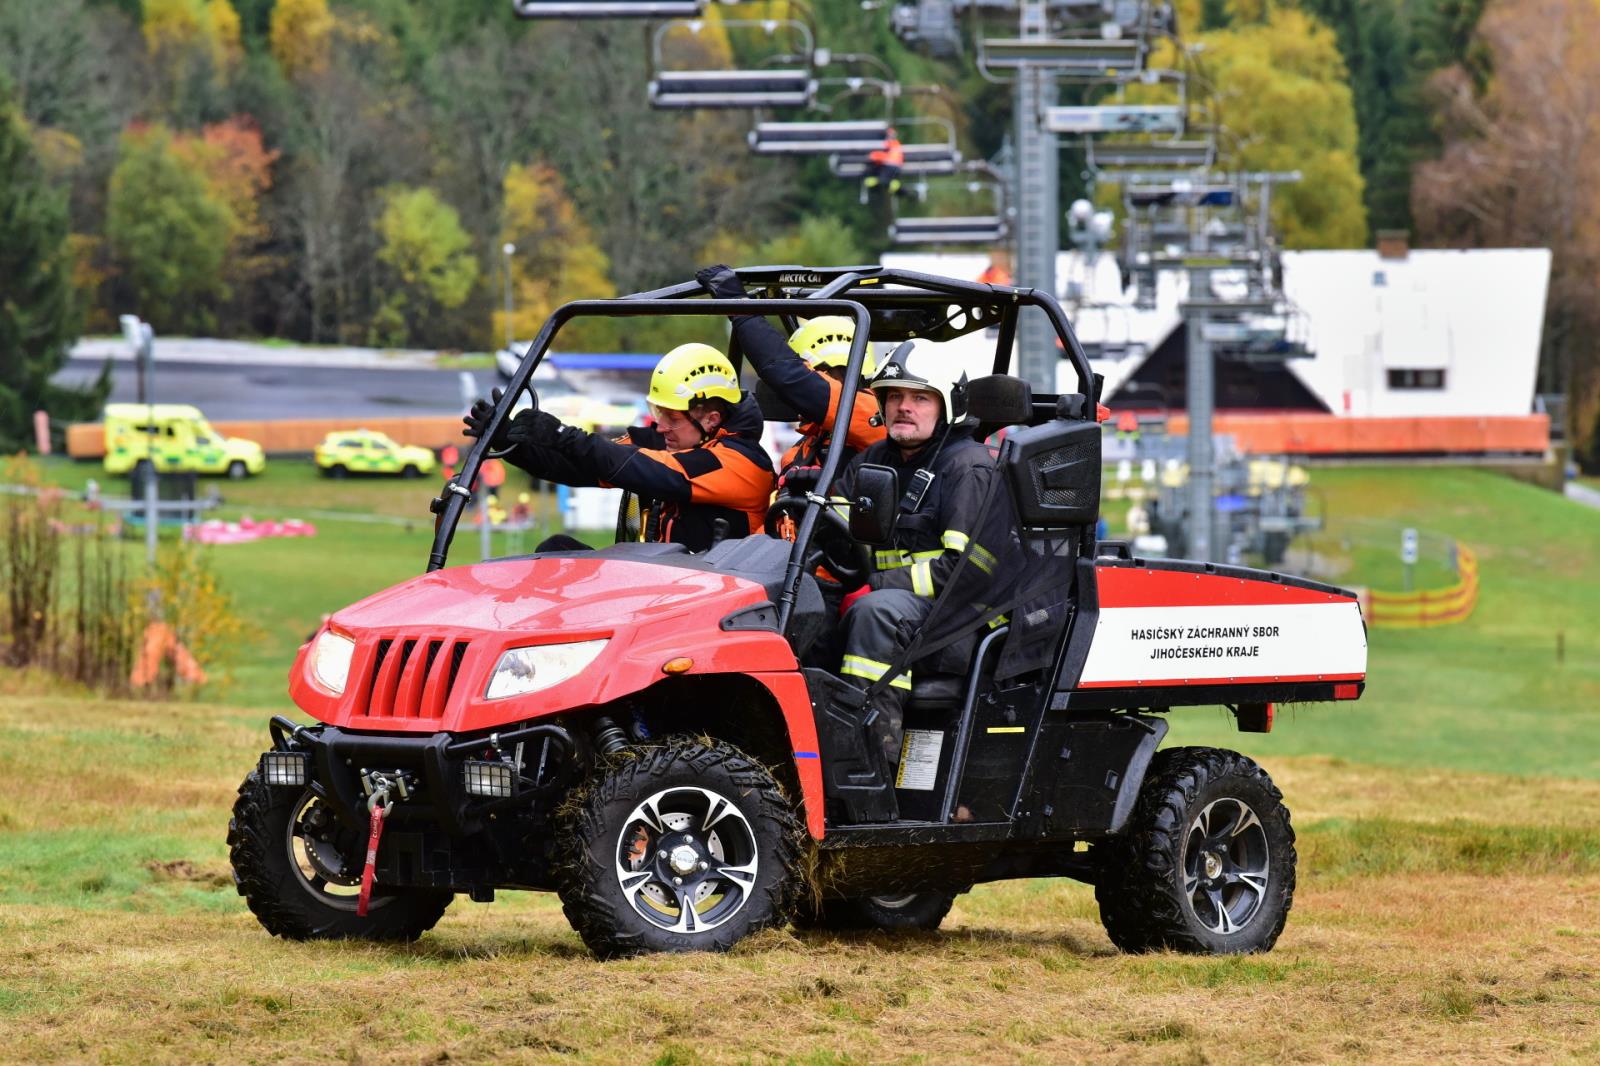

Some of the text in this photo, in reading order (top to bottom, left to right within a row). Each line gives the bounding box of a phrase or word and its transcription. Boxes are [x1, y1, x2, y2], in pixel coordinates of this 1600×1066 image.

[779, 273, 807, 283] ARCTIC
[1131, 625, 1280, 640] HASIČSKÝ ZÁCHRANNÝ SBOR
[1150, 645, 1260, 659] JIHOČESKÉHO KRAJE
